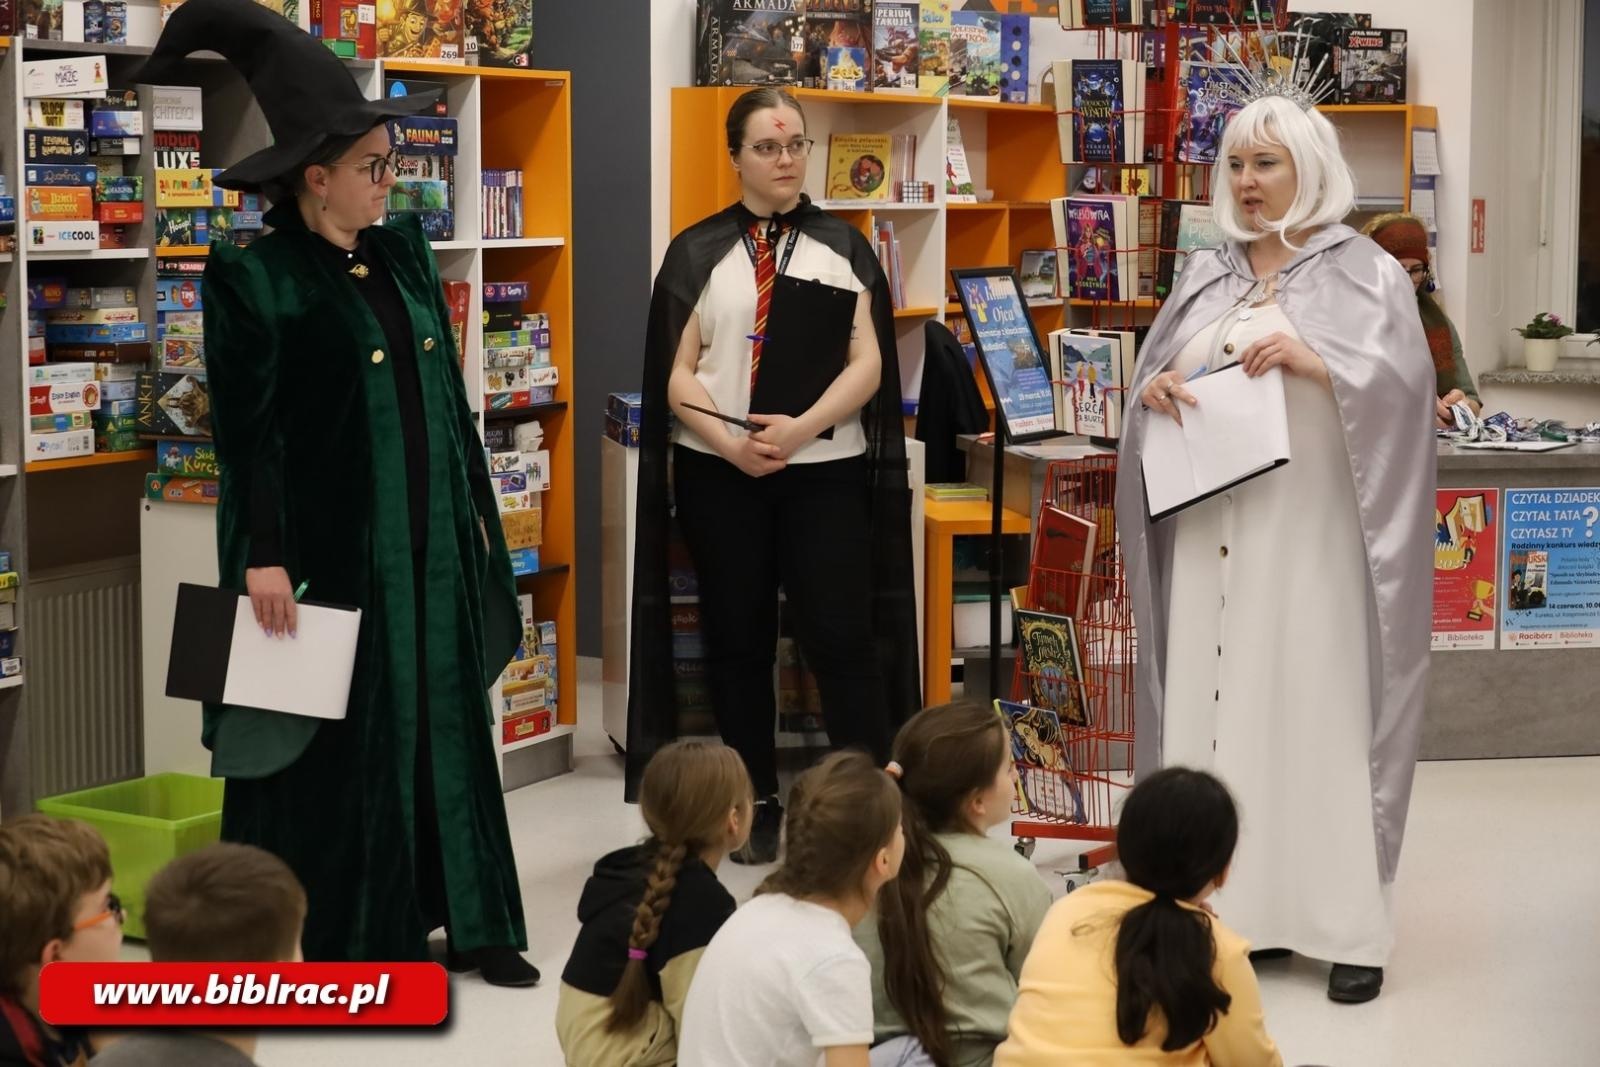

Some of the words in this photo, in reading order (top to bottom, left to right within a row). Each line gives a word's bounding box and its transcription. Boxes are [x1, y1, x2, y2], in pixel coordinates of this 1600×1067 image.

[733, 0, 797, 11] ARMADA
[466, 42, 476, 50] 10
[1348, 36, 1384, 48] X-WING
[440, 50, 458, 60] 269
[710, 16, 719, 84] ARMADA
[55, 70, 80, 84] MAZE
[40, 102, 65, 116] BLOCK
[154, 132, 200, 152] mbury
[406, 129, 440, 144] FAUNA
[154, 151, 200, 170] LUXE
[58, 230, 96, 241] ICECOOL
[138, 374, 152, 426] ANKH
[1512, 493, 1551, 504] CZYTAŁ
[1554, 492, 1600, 504] DZIADEK
[1511, 510, 1551, 522] CZYTAŁ
[1554, 510, 1581, 520] TATA
[1582, 506, 1598, 538] ?
[1510, 528, 1558, 540] CZYTASZ
[1560, 528, 1574, 538] TY
[1512, 542, 1545, 550] Rodzinny
